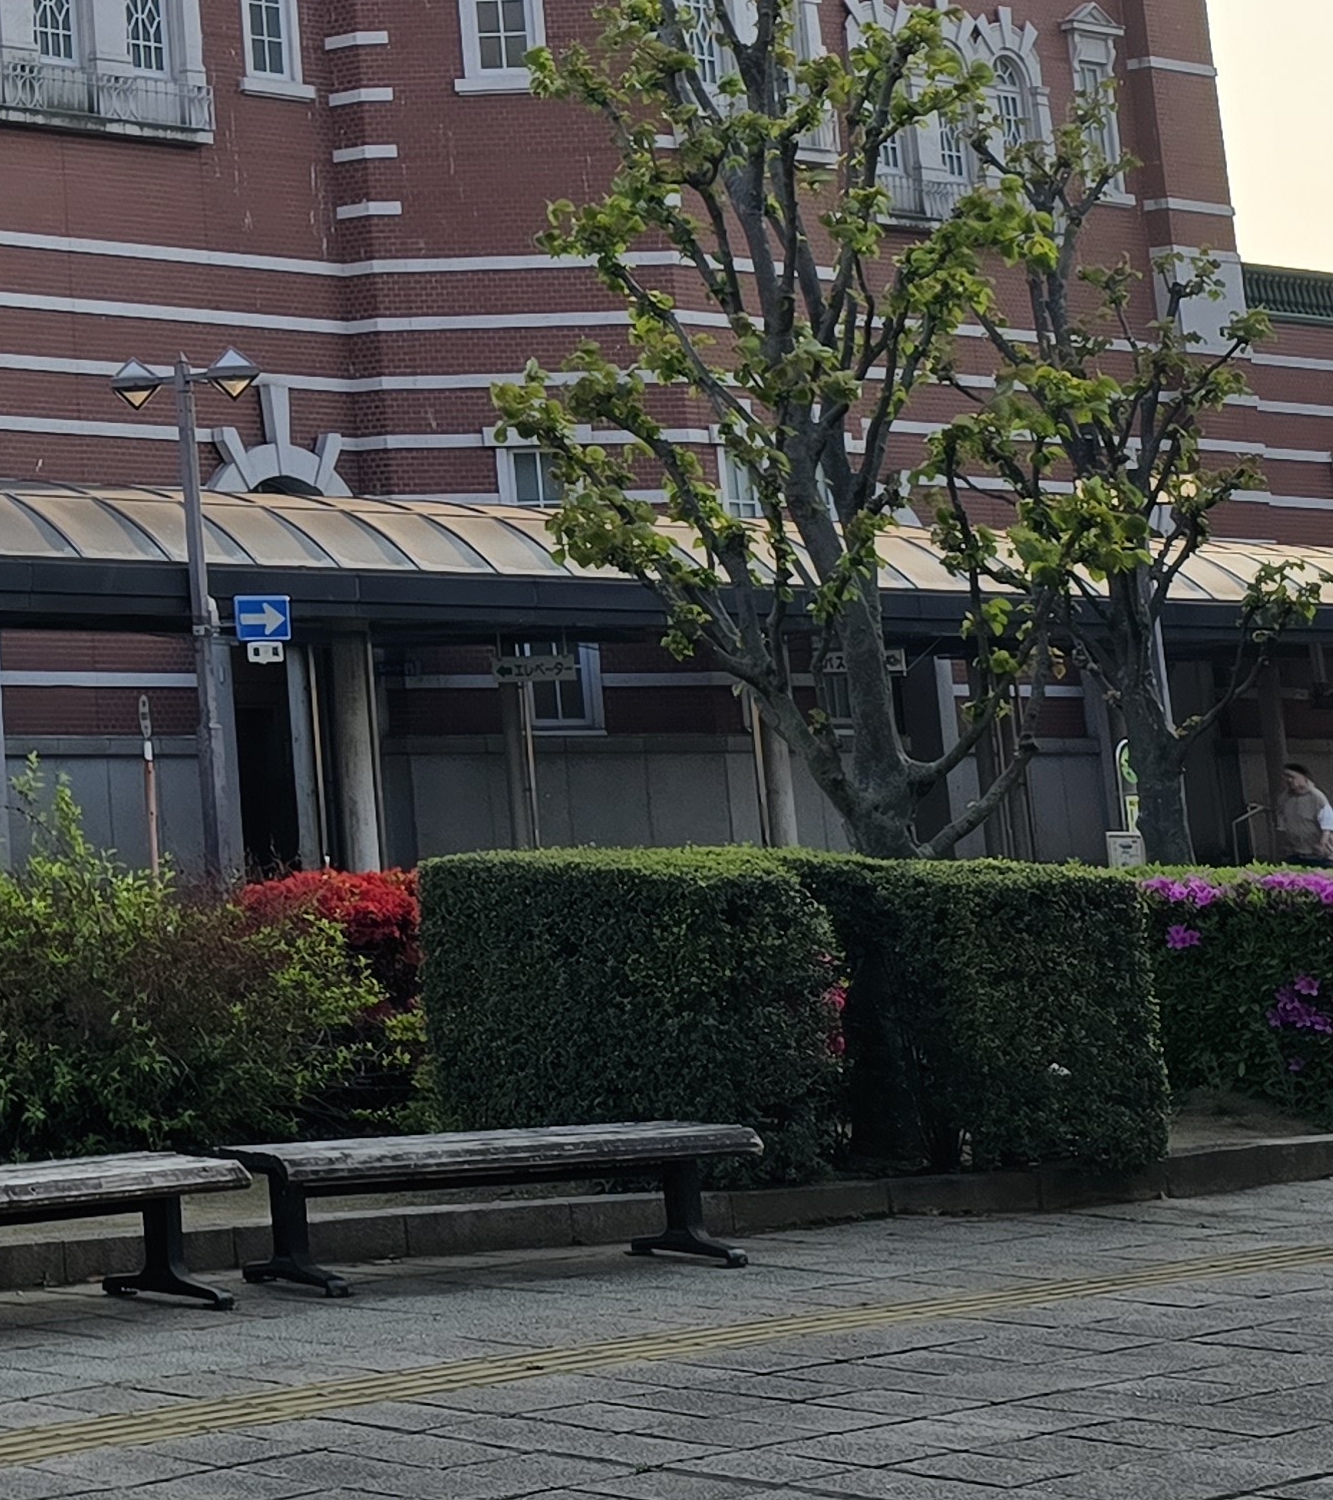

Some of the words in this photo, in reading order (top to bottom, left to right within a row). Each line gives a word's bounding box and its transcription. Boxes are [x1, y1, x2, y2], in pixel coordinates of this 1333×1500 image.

[514, 661, 573, 677] エレベーター
